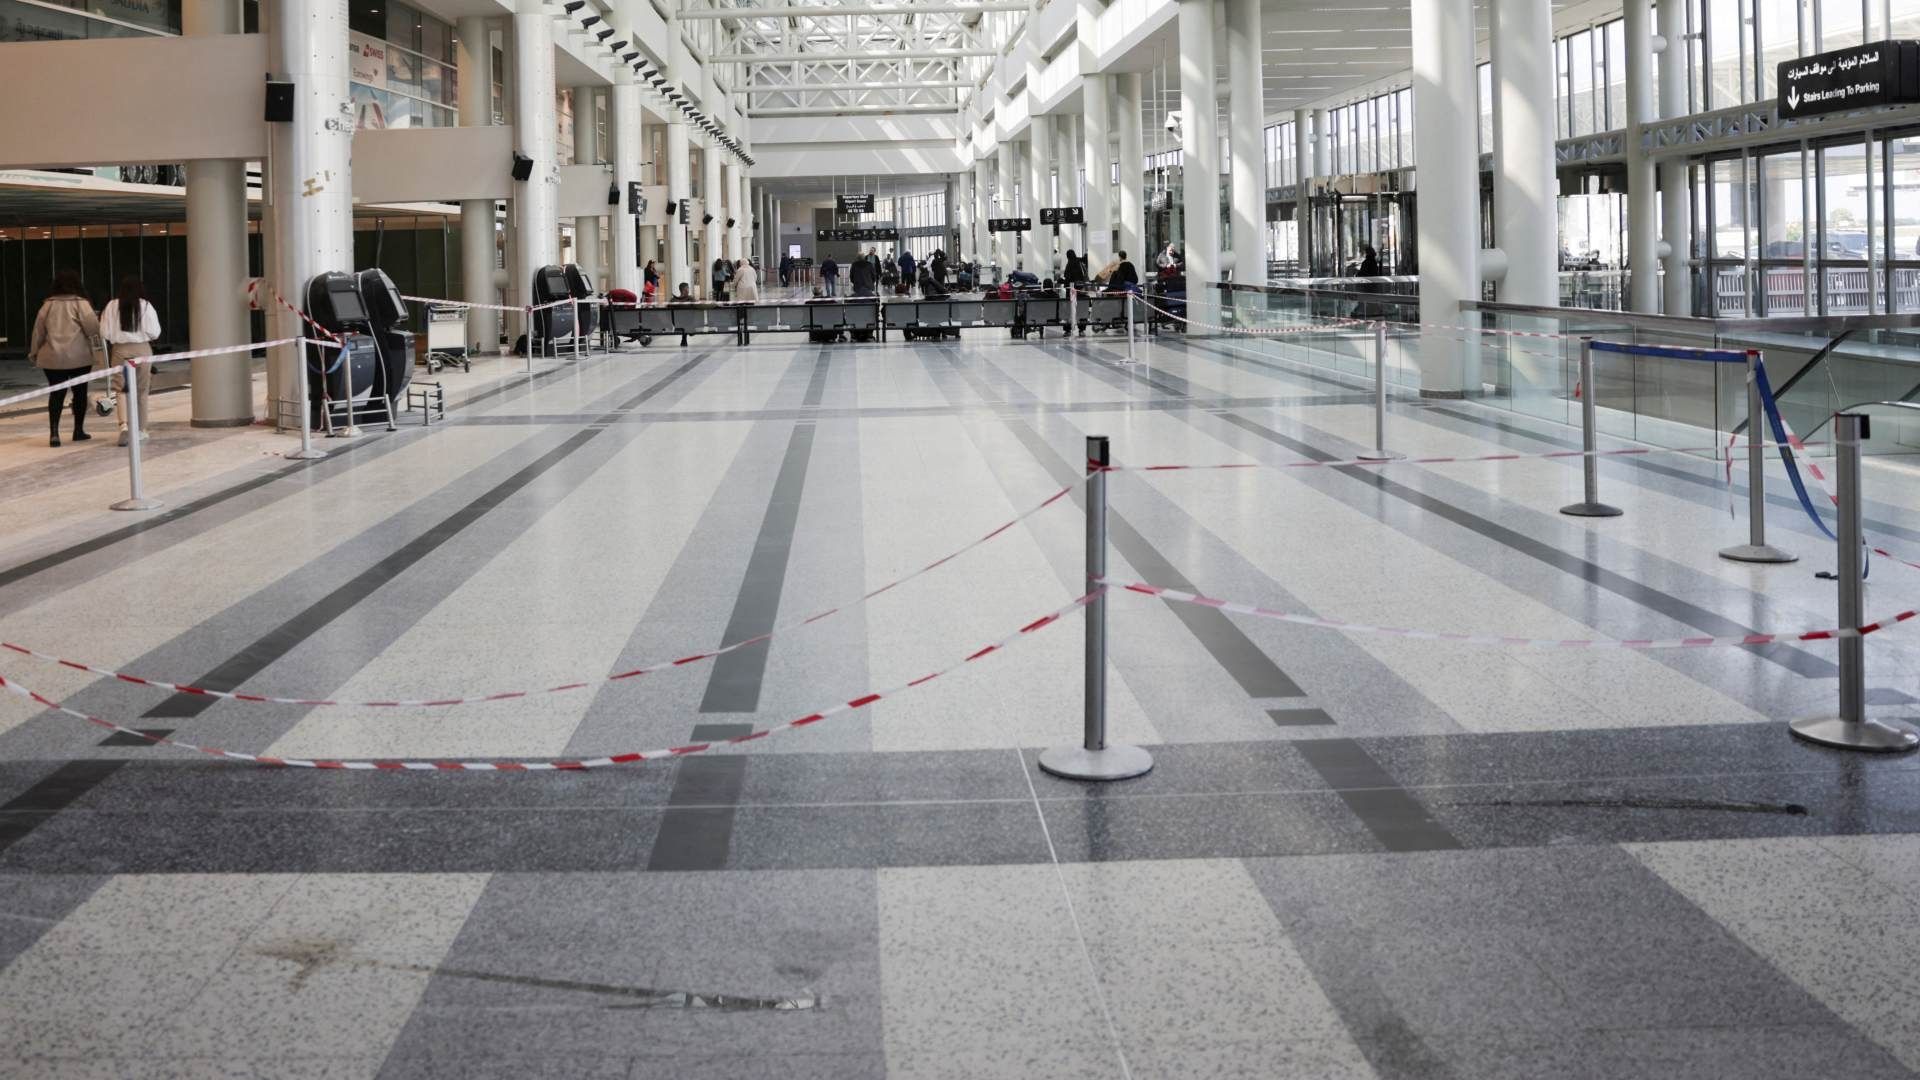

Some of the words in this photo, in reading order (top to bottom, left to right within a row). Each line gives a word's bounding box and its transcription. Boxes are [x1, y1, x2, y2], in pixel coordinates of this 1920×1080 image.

[369, 47, 384, 60] SWISS
[1859, 51, 1879, 68] السلالم
[1787, 66, 1809, 80] السيارات
[1803, 91, 1821, 103] Stairs
[1821, 88, 1846, 100] Leading
[1846, 85, 1855, 95] To
[1855, 82, 1880, 94] Parking
